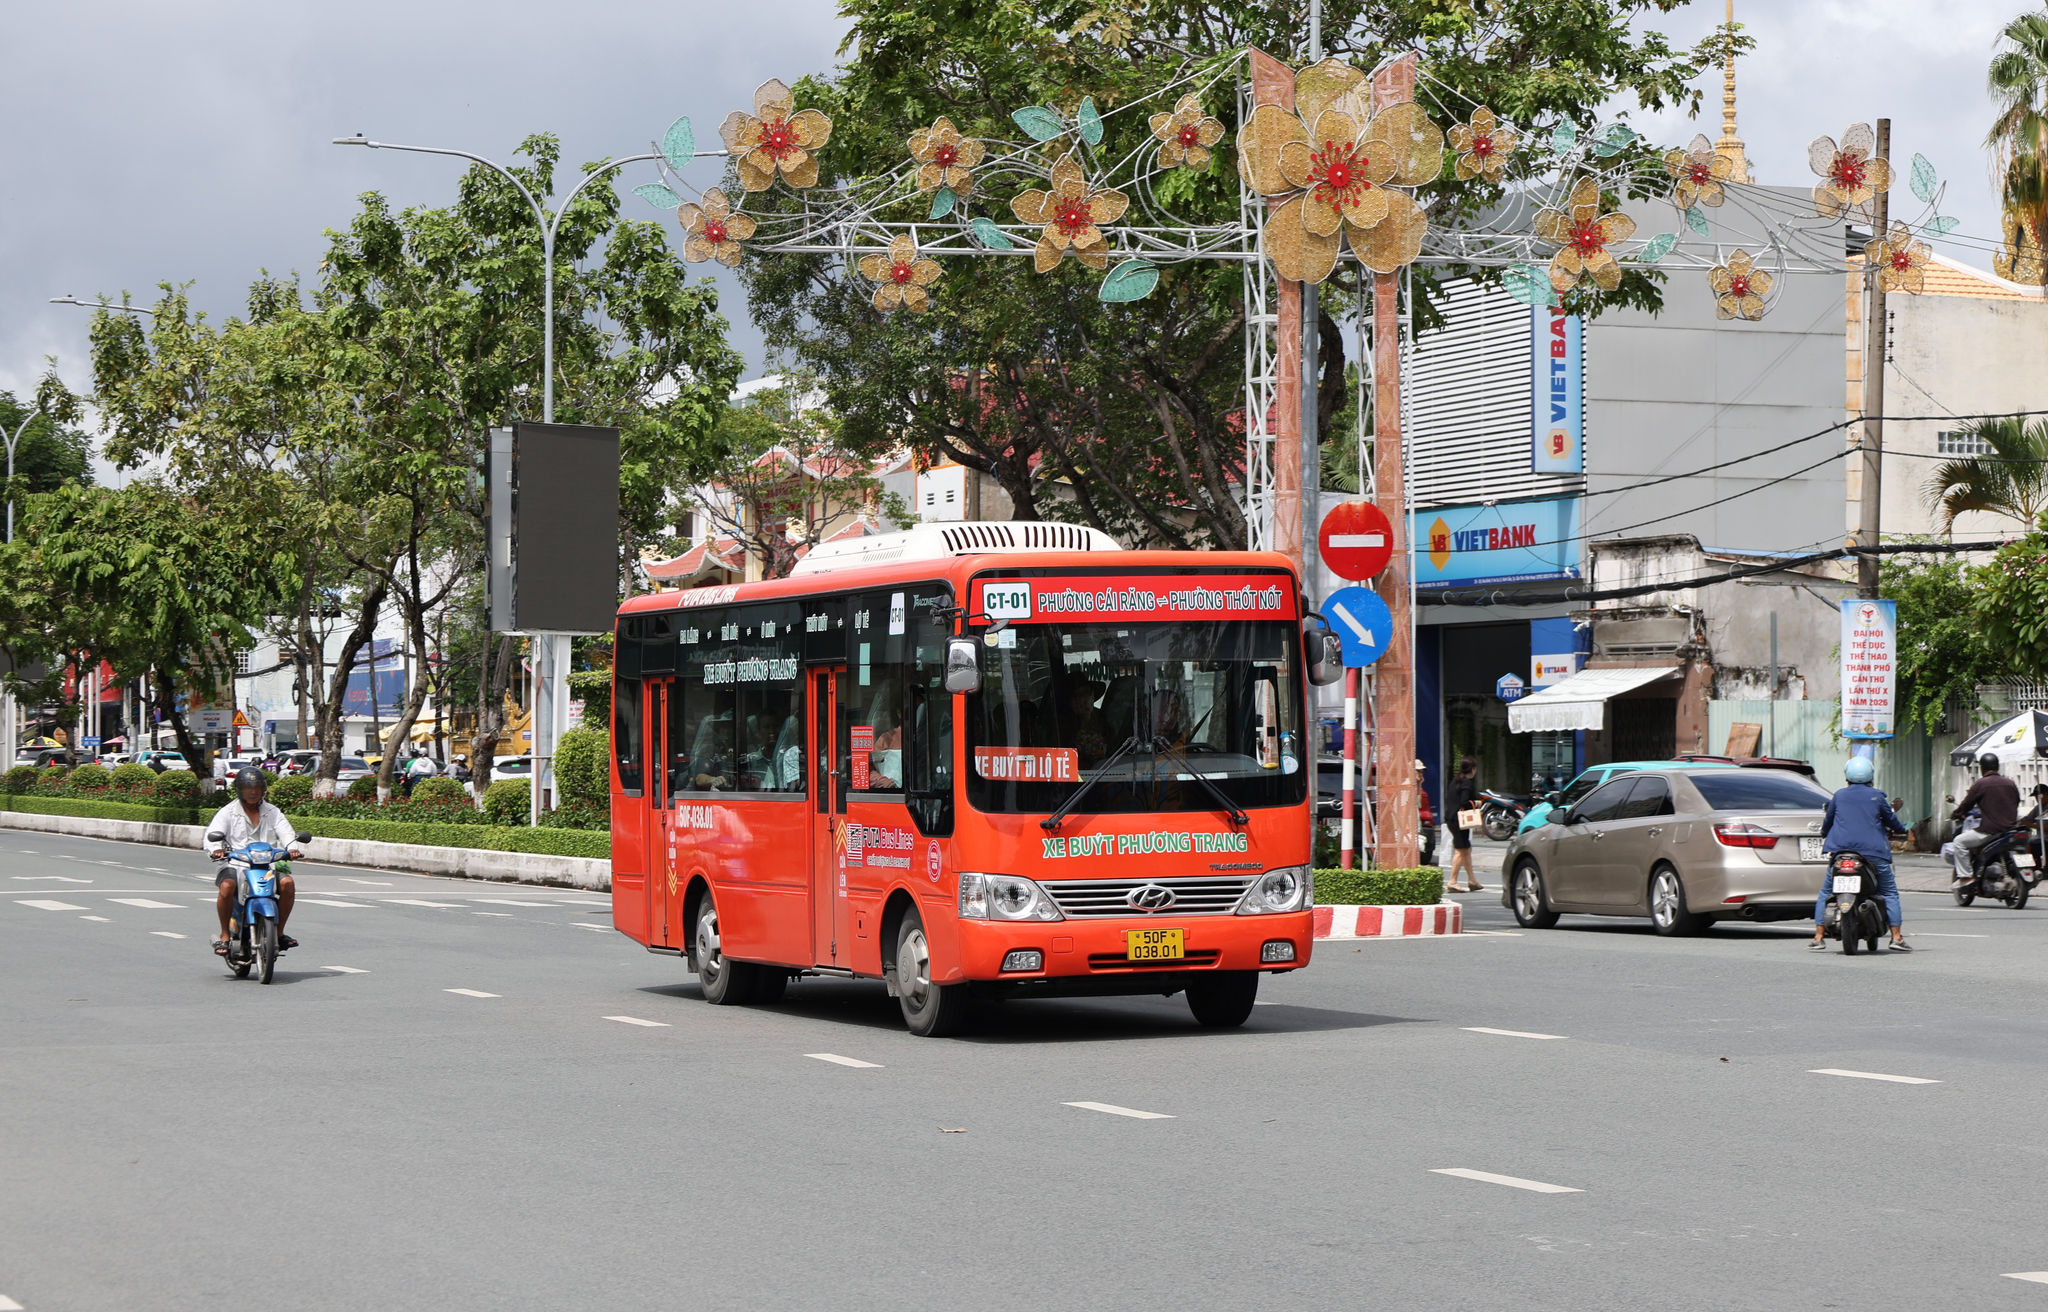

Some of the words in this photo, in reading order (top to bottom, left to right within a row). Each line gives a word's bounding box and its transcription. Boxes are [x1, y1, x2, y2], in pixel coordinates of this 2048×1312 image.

[1453, 524, 1536, 553] VIETBANK
[987, 592, 1027, 609] CT-01
[1038, 587, 1093, 612] PHƯỜNG
[1096, 587, 1118, 611] CÁI
[1120, 587, 1155, 611] RĂNG
[1169, 585, 1222, 610] PHƯỜNG
[1224, 584, 1257, 610] THỐT
[1258, 584, 1282, 610] NỐT
[891, 607, 904, 624] CT-01
[1868, 641, 1886, 650] DỤC
[1868, 652, 1888, 660] THAO
[703, 664, 714, 684] XE
[714, 659, 736, 683] BUÝT
[736, 656, 768, 681] PHƯƠNG
[769, 658, 797, 680] TRANG
[1873, 662, 1890, 672] PHỐ
[1502, 688, 1522, 698] ATM
[1882, 687, 1888, 695] X
[1039, 752, 1052, 782] LỘ
[1056, 751, 1070, 778] TẺ
[680, 805, 713, 829] 50F-038.01
[862, 827, 880, 848] FUTA
[880, 827, 895, 849] Bus
[894, 828, 914, 850] Lines
[1042, 837, 1065, 858] XE
[1069, 832, 1114, 856] BUÝT
[1118, 831, 1190, 854] PHƯƠNG
[1192, 832, 1248, 853] TRANG
[1143, 930, 1167, 944] 50F
[1134, 945, 1177, 959] 038.01
